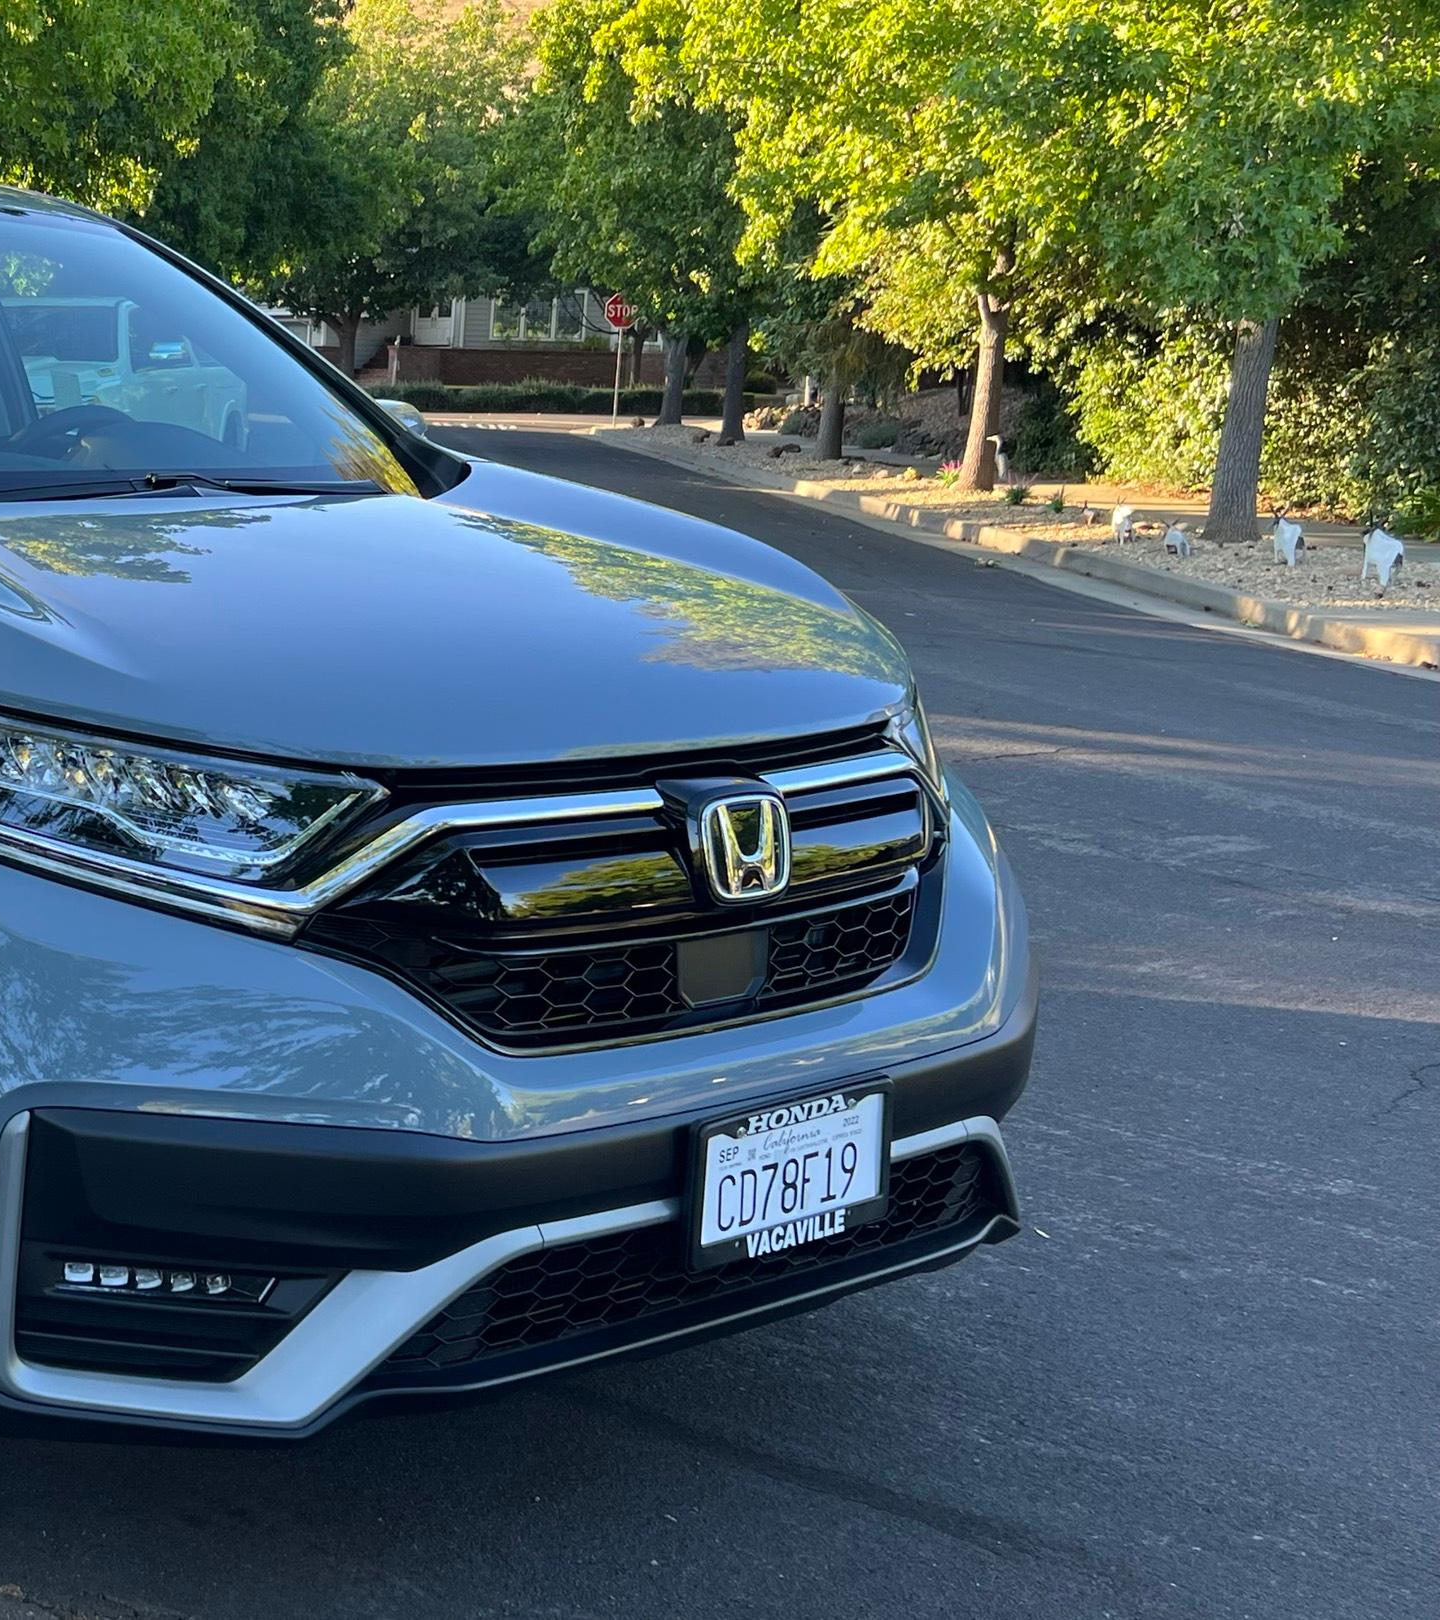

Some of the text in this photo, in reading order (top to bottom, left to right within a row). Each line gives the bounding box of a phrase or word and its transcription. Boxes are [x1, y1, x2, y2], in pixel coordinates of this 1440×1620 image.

[607, 304, 639, 318] STOP
[746, 1094, 848, 1136] HONDA
[718, 1145, 739, 1164] SEP
[763, 1128, 822, 1154] California
[717, 1141, 858, 1232] CD78F19
[746, 1209, 846, 1258] VACAVILLE
